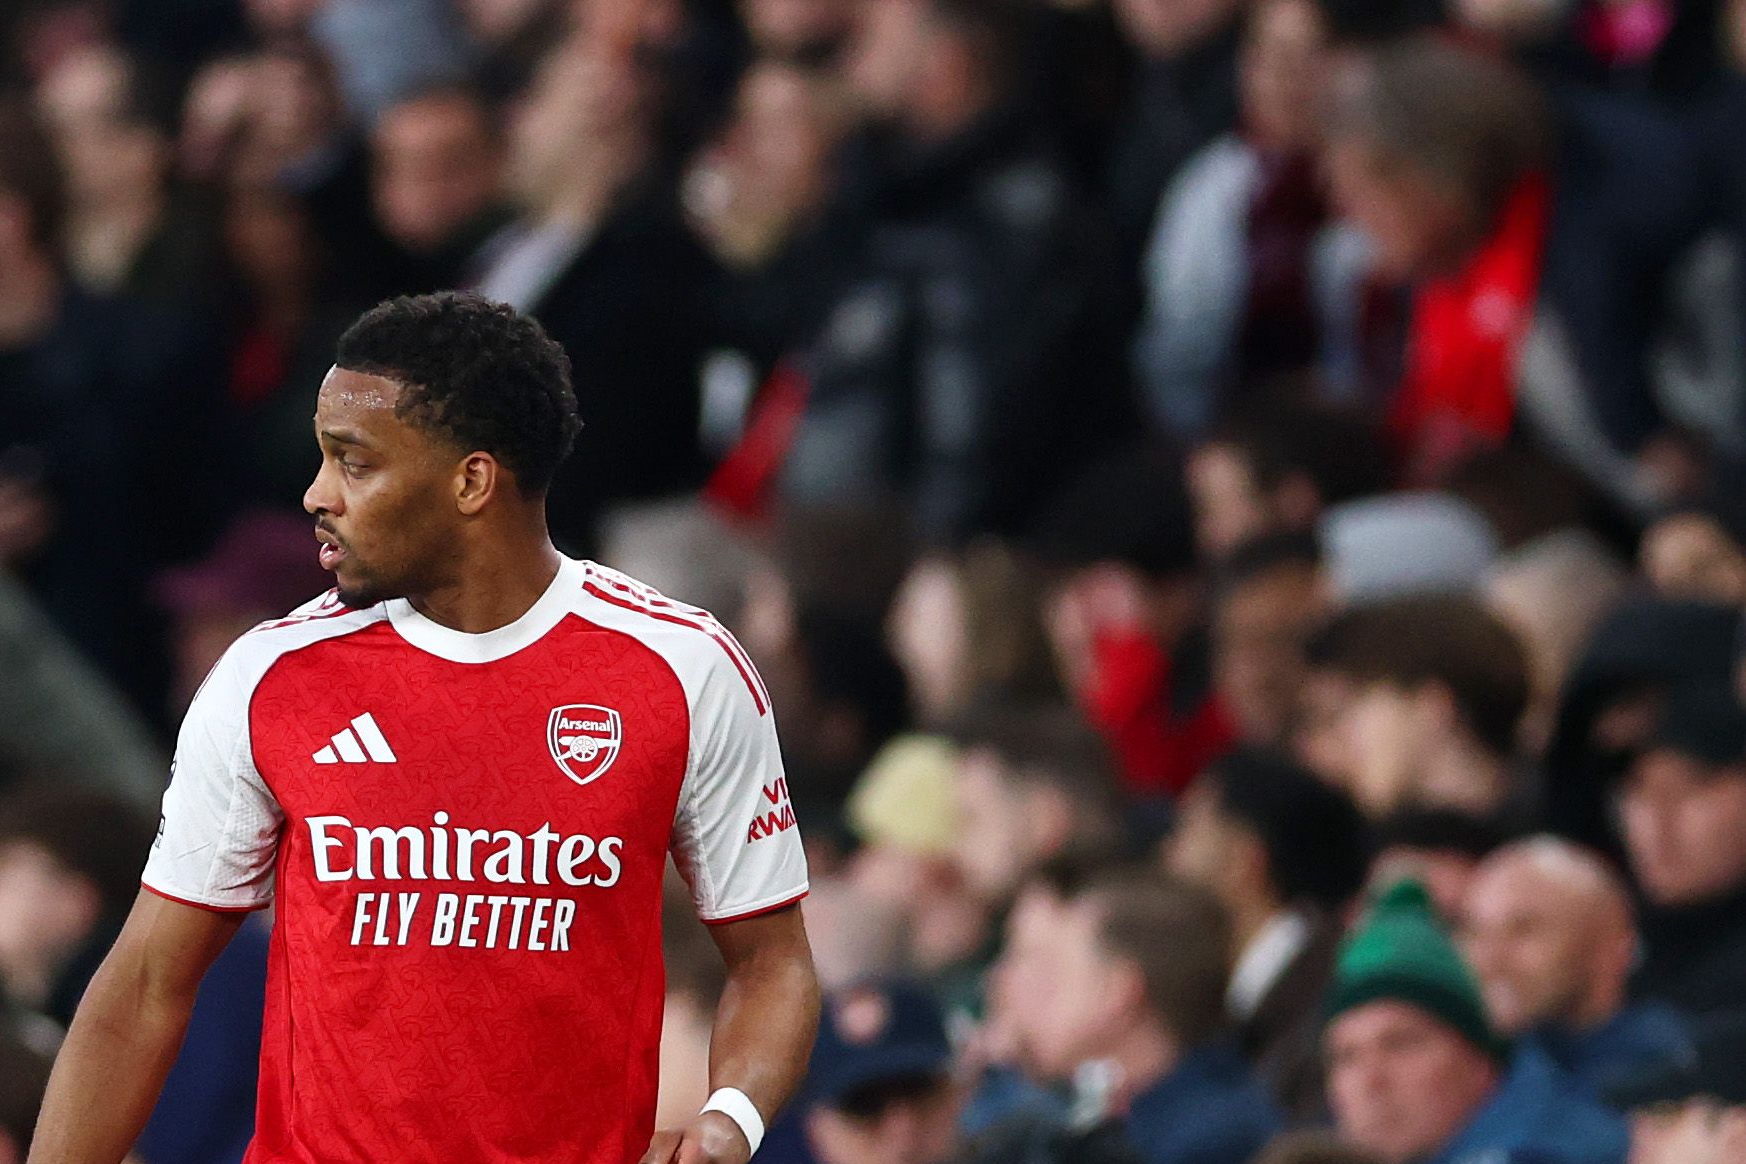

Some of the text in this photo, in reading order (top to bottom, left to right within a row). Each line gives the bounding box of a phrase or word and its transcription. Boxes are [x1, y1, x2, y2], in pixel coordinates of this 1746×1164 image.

[558, 717, 611, 732] Arsenal
[304, 810, 624, 887] Emirates
[350, 892, 576, 952] FLY BETTER
